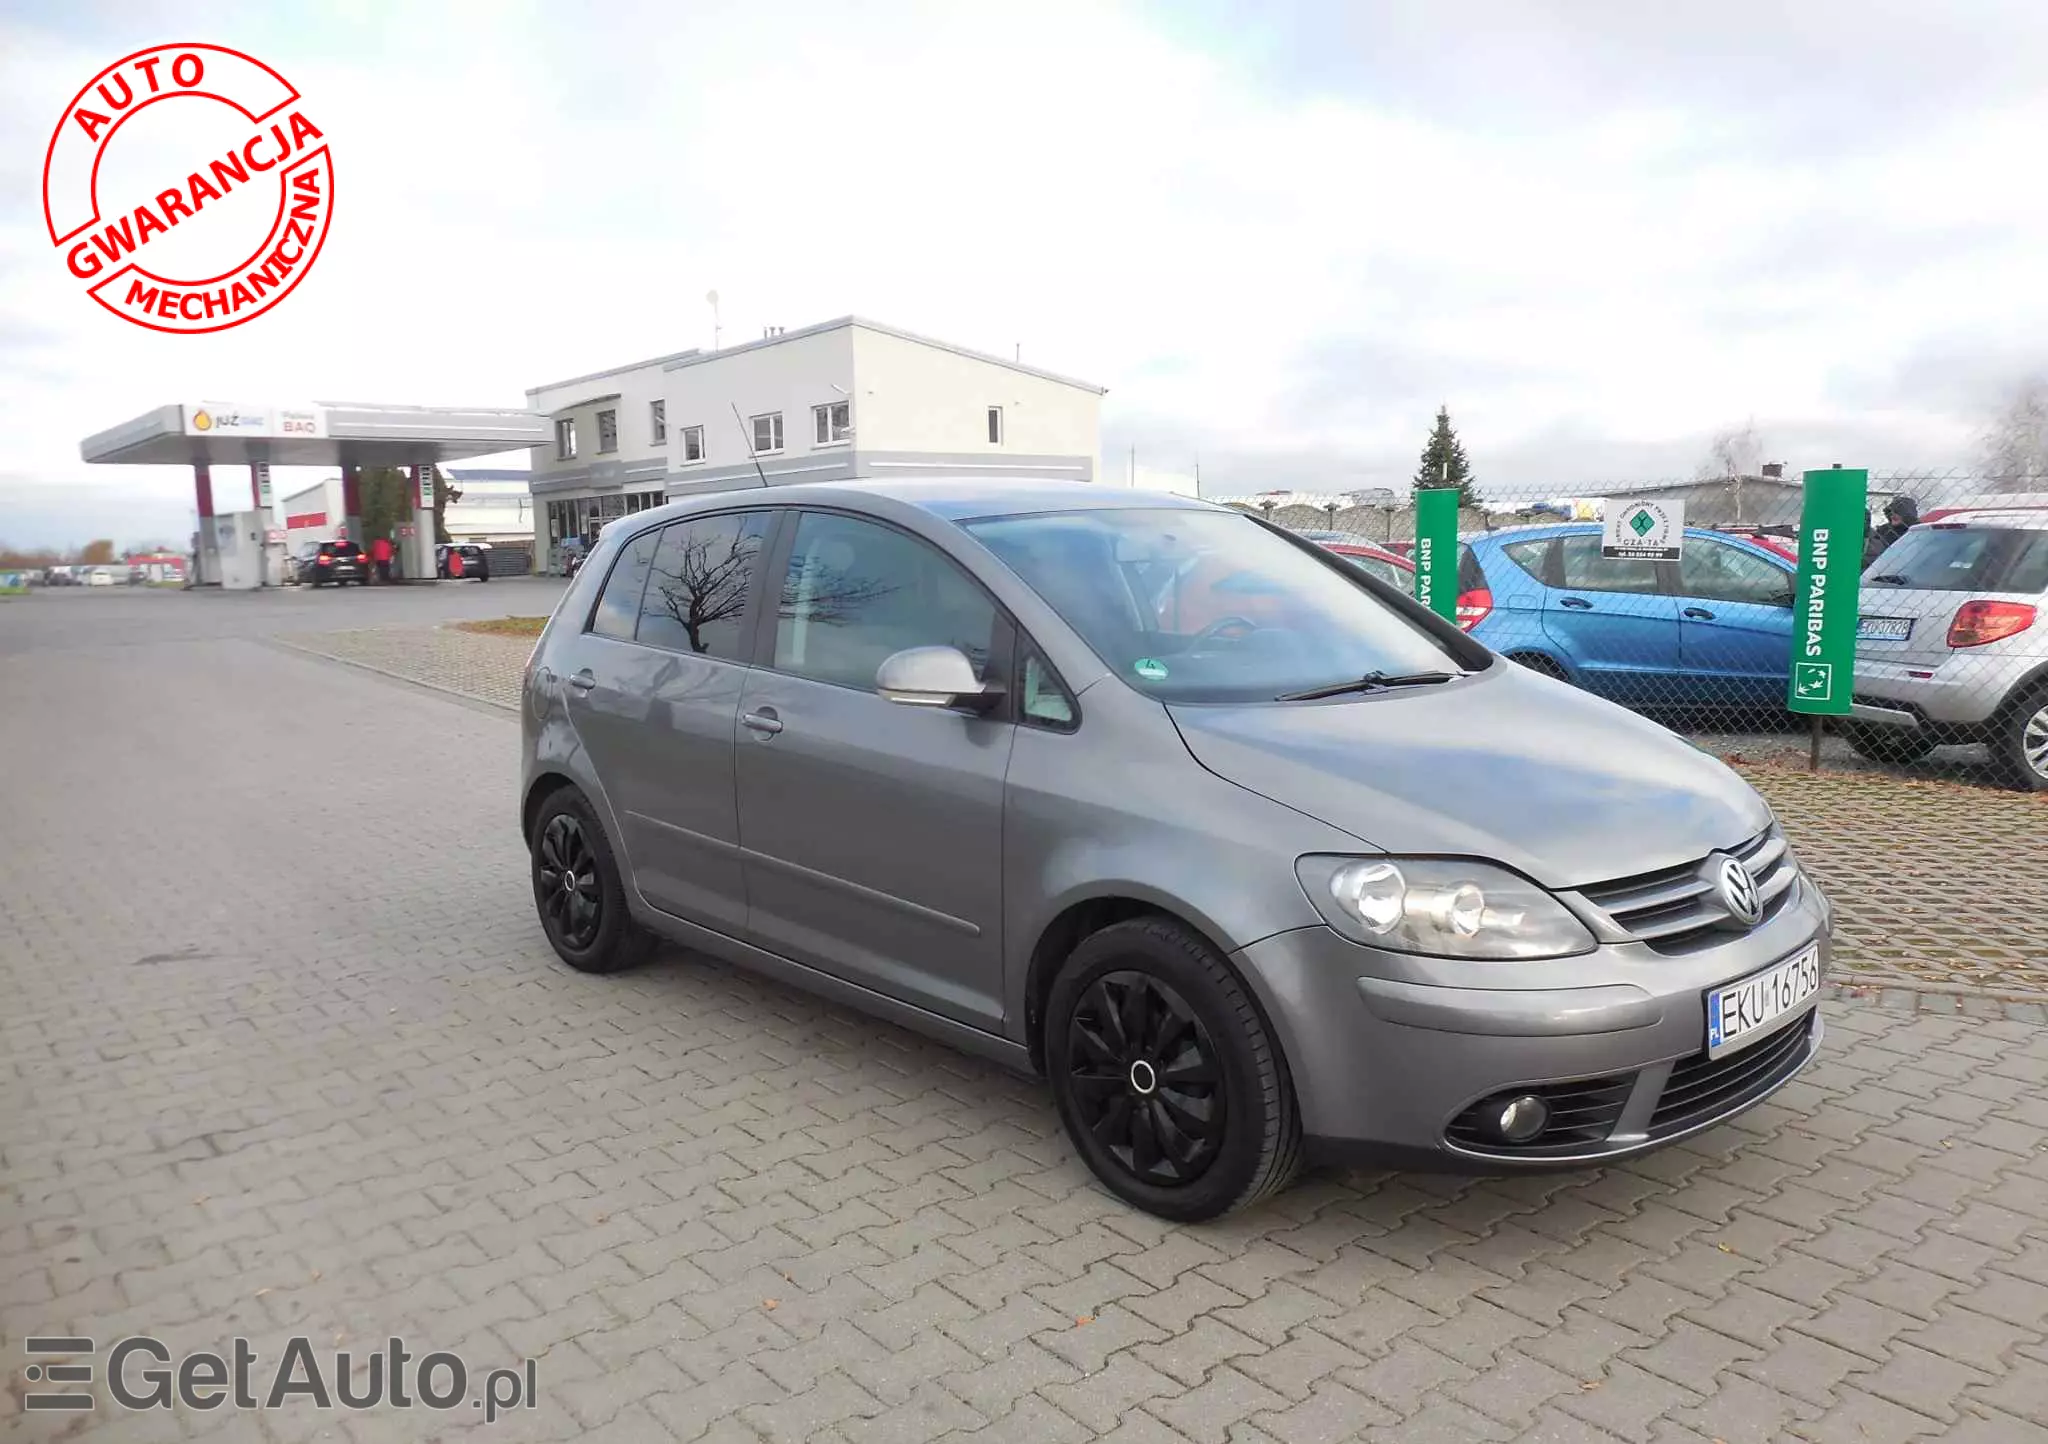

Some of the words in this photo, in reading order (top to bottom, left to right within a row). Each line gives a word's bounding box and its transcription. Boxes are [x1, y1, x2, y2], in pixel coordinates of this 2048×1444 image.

[1421, 538, 1431, 571] BNP
[1812, 528, 1829, 570] BNP
[1420, 575, 1431, 608] PAR
[1806, 574, 1826, 656] PARIBAS
[1722, 981, 1764, 1038] EKU
[1772, 950, 1817, 1014] 16756
